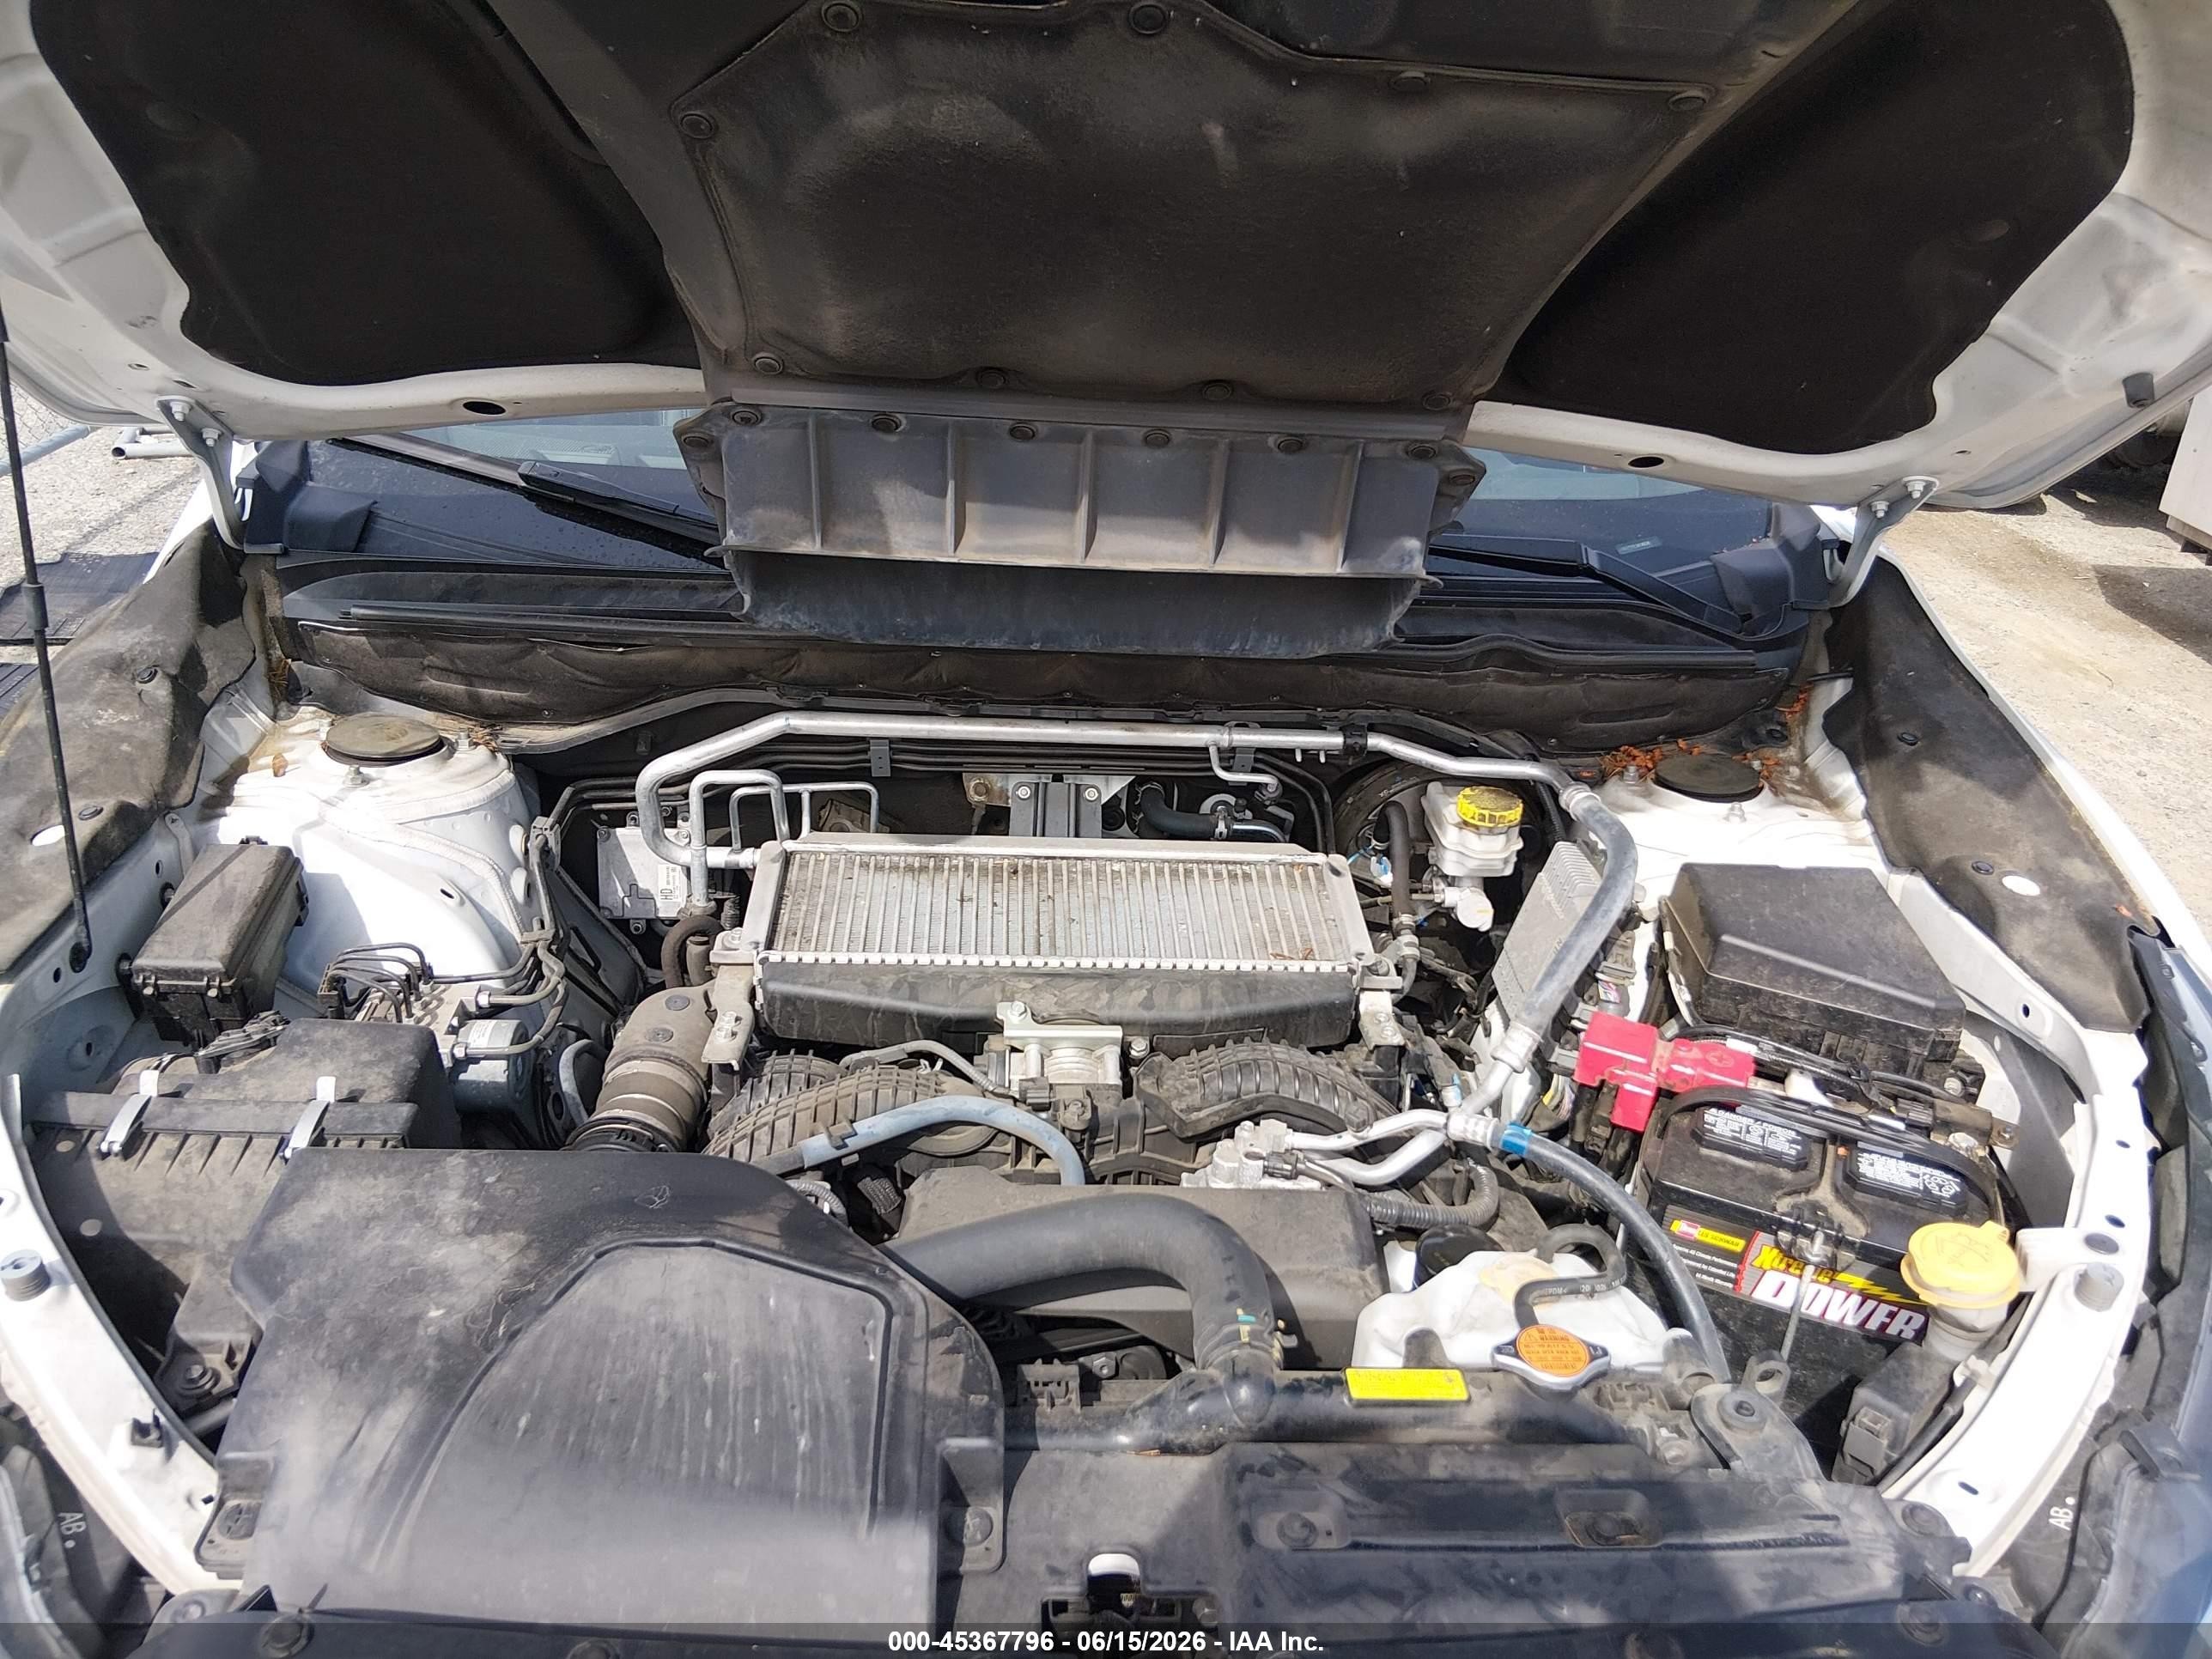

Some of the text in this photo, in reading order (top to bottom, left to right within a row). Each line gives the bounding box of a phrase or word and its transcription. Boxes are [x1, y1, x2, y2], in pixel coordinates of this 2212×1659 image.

[660, 888, 673, 901] HD
[1751, 1244, 1834, 1284] Xtree
[58, 1511, 87, 1535] AB
[2048, 1506, 2074, 1531] AB
